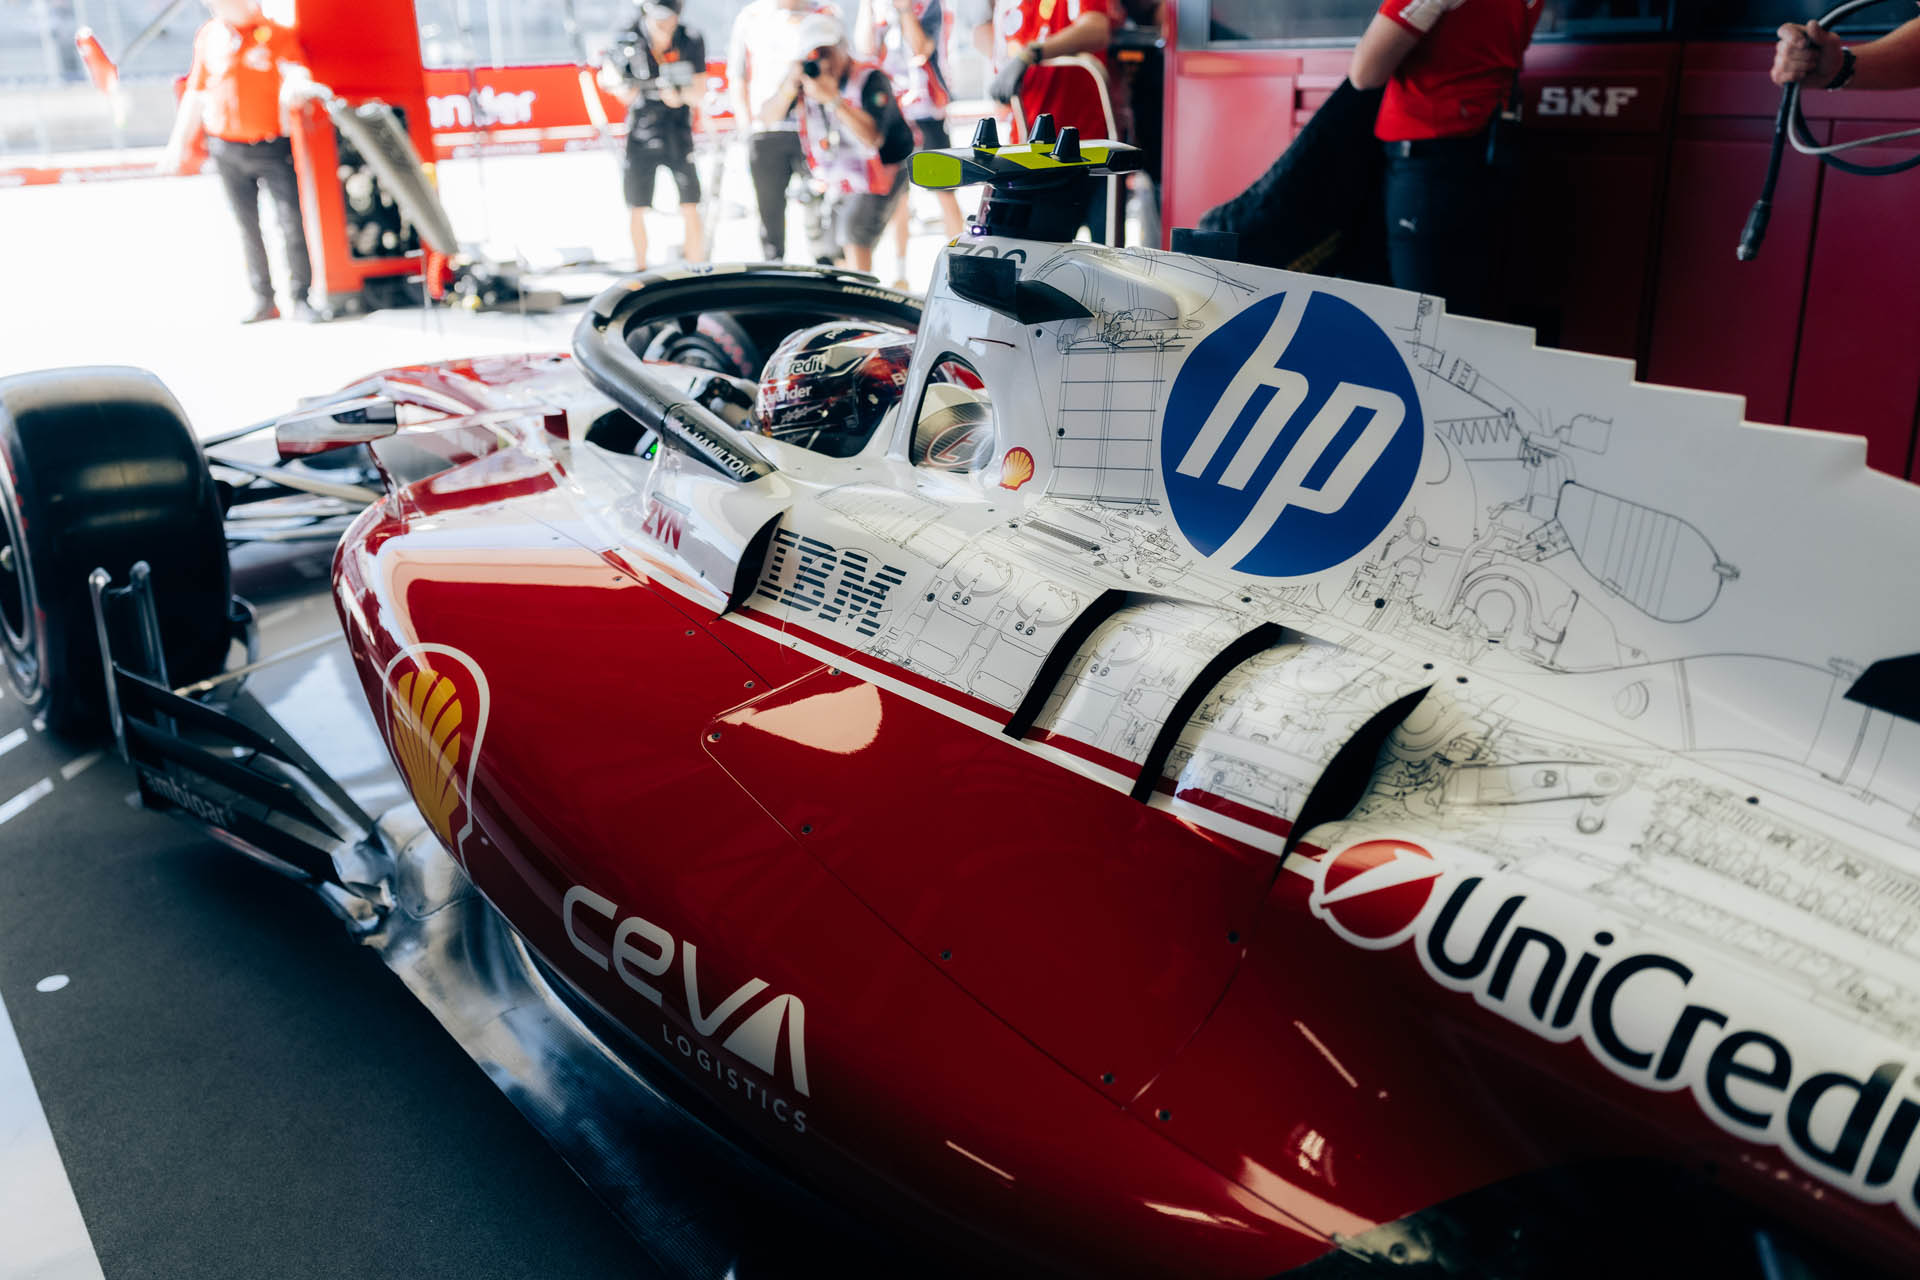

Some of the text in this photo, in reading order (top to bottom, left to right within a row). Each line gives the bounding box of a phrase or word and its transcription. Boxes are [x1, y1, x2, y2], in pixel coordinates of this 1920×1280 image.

[1538, 86, 1638, 117] SKF
[692, 430, 755, 478] HAMILTON
[1173, 291, 1407, 571] hp
[641, 499, 682, 551] ZYN
[756, 528, 907, 637] IBM
[662, 1023, 807, 1133] LOGISTICS
[1427, 876, 1920, 1209] UniCredi
